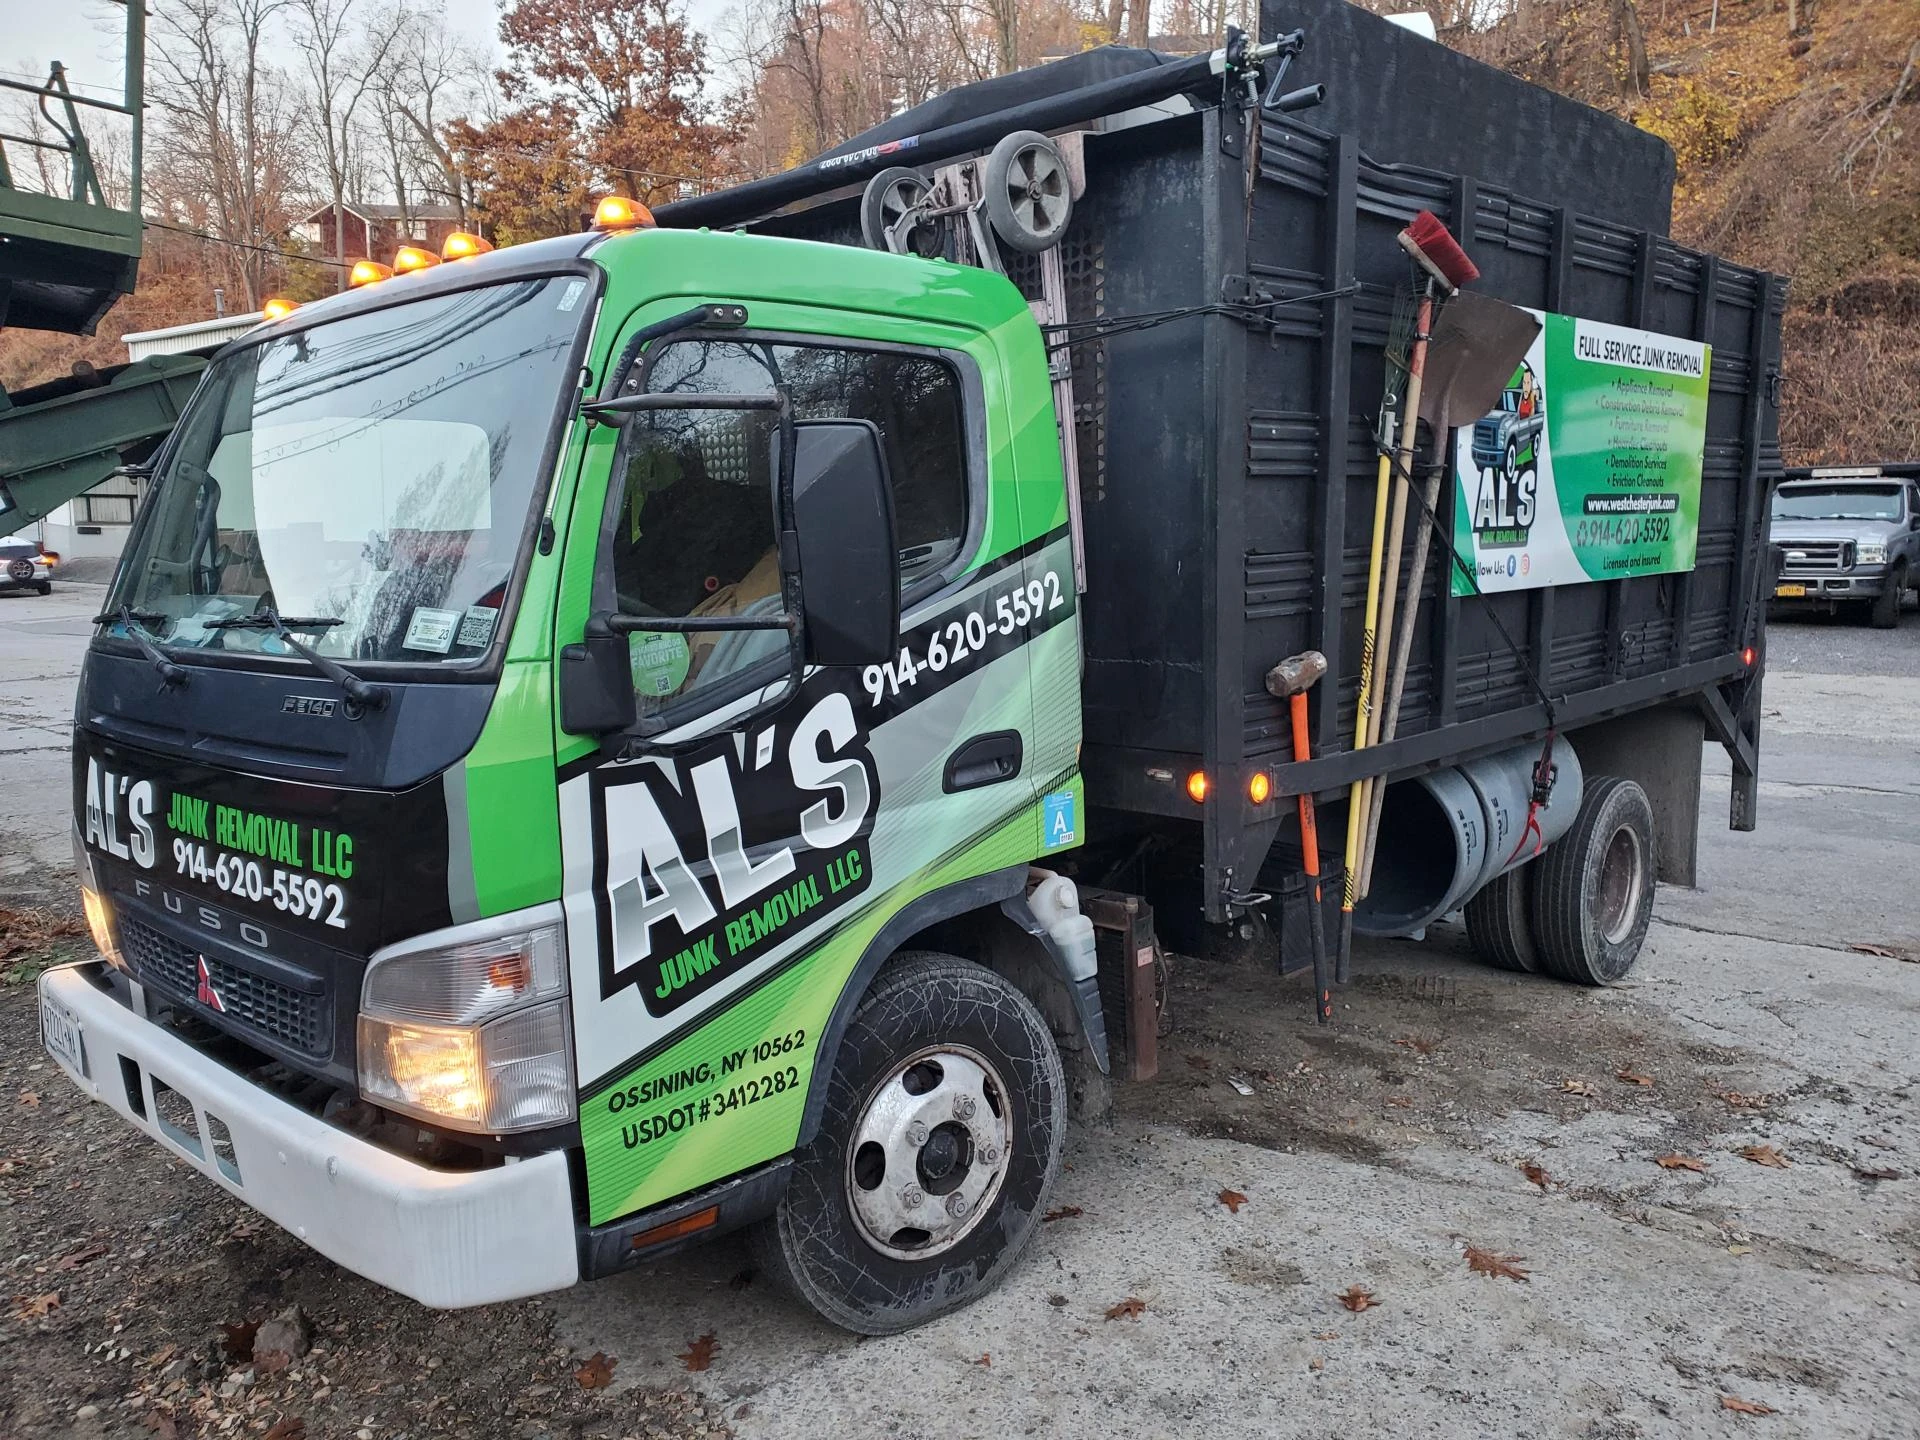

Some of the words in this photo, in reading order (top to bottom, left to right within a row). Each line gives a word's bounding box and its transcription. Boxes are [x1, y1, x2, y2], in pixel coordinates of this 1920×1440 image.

[1579, 336, 1601, 358] FULL
[1604, 340, 1641, 365] SERVICE
[1643, 346, 1664, 369] JUNK
[1666, 352, 1702, 374] REMOVAL
[1600, 395, 1640, 413] Construction
[1617, 378, 1646, 396] Appliance
[1649, 382, 1674, 397] Removal
[1610, 454, 1643, 469] Demolition
[1644, 456, 1667, 469] Services
[1612, 473, 1636, 488] Eviction
[1637, 473, 1664, 487] Cleanouts
[1475, 467, 1536, 528] AL'S
[1588, 494, 1675, 514] www.westchesterjunk.com
[1590, 517, 1670, 546] 914-620-5592
[1603, 556, 1629, 570] Licensed
[1630, 555, 1640, 567] and
[1641, 552, 1661, 566] Insured
[438, 629, 449, 640] 23
[863, 571, 1065, 708] 914-620-5592
[86, 756, 155, 869] AL'S
[1053, 811, 1067, 835] A
[167, 792, 209, 840] JUNK
[215, 804, 302, 868] REMOVAL
[312, 828, 353, 879] LLC
[604, 692, 870, 975] AL'S
[173, 838, 346, 929] 914-620-5592
[135, 879, 268, 948] FUSO
[654, 930, 721, 999] JUNK
[724, 874, 824, 957] REMOVAL
[826, 849, 863, 894] LLC
[608, 1062, 716, 1114] OSSINING,
[721, 1048, 748, 1076] NY
[752, 1029, 805, 1064] 10562
